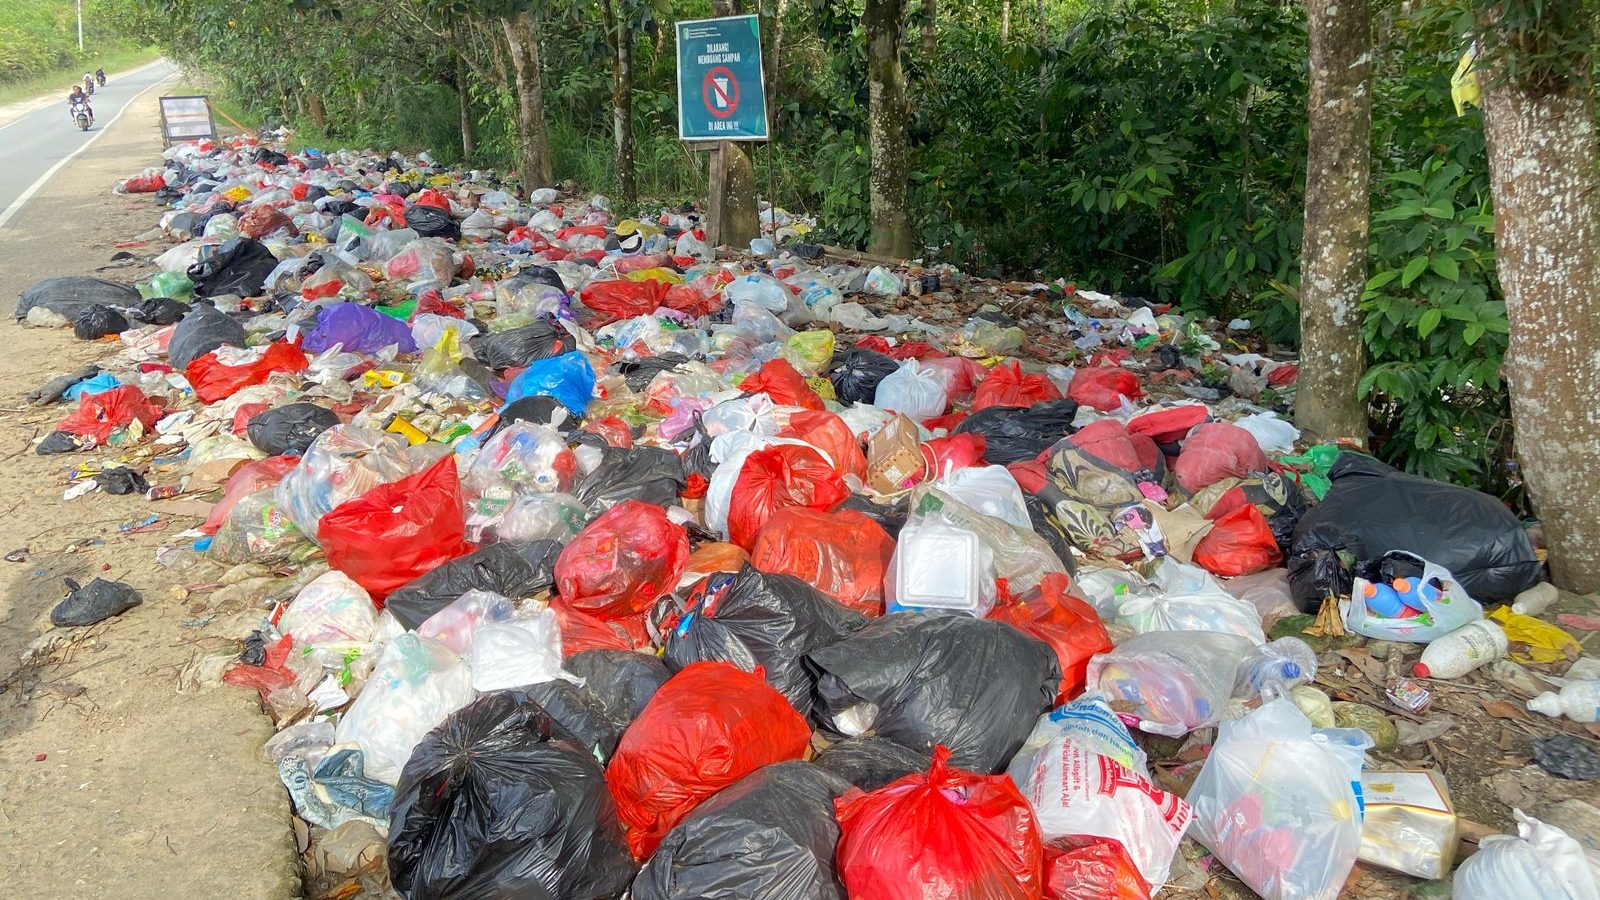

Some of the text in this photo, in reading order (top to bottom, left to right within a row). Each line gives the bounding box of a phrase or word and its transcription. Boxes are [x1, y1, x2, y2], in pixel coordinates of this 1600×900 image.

[697, 52, 741, 65] MEMBUANG SAMPAH
[708, 121, 714, 131] DI
[714, 121, 726, 131] AREA
[1062, 763, 1070, 792] Alfamart
